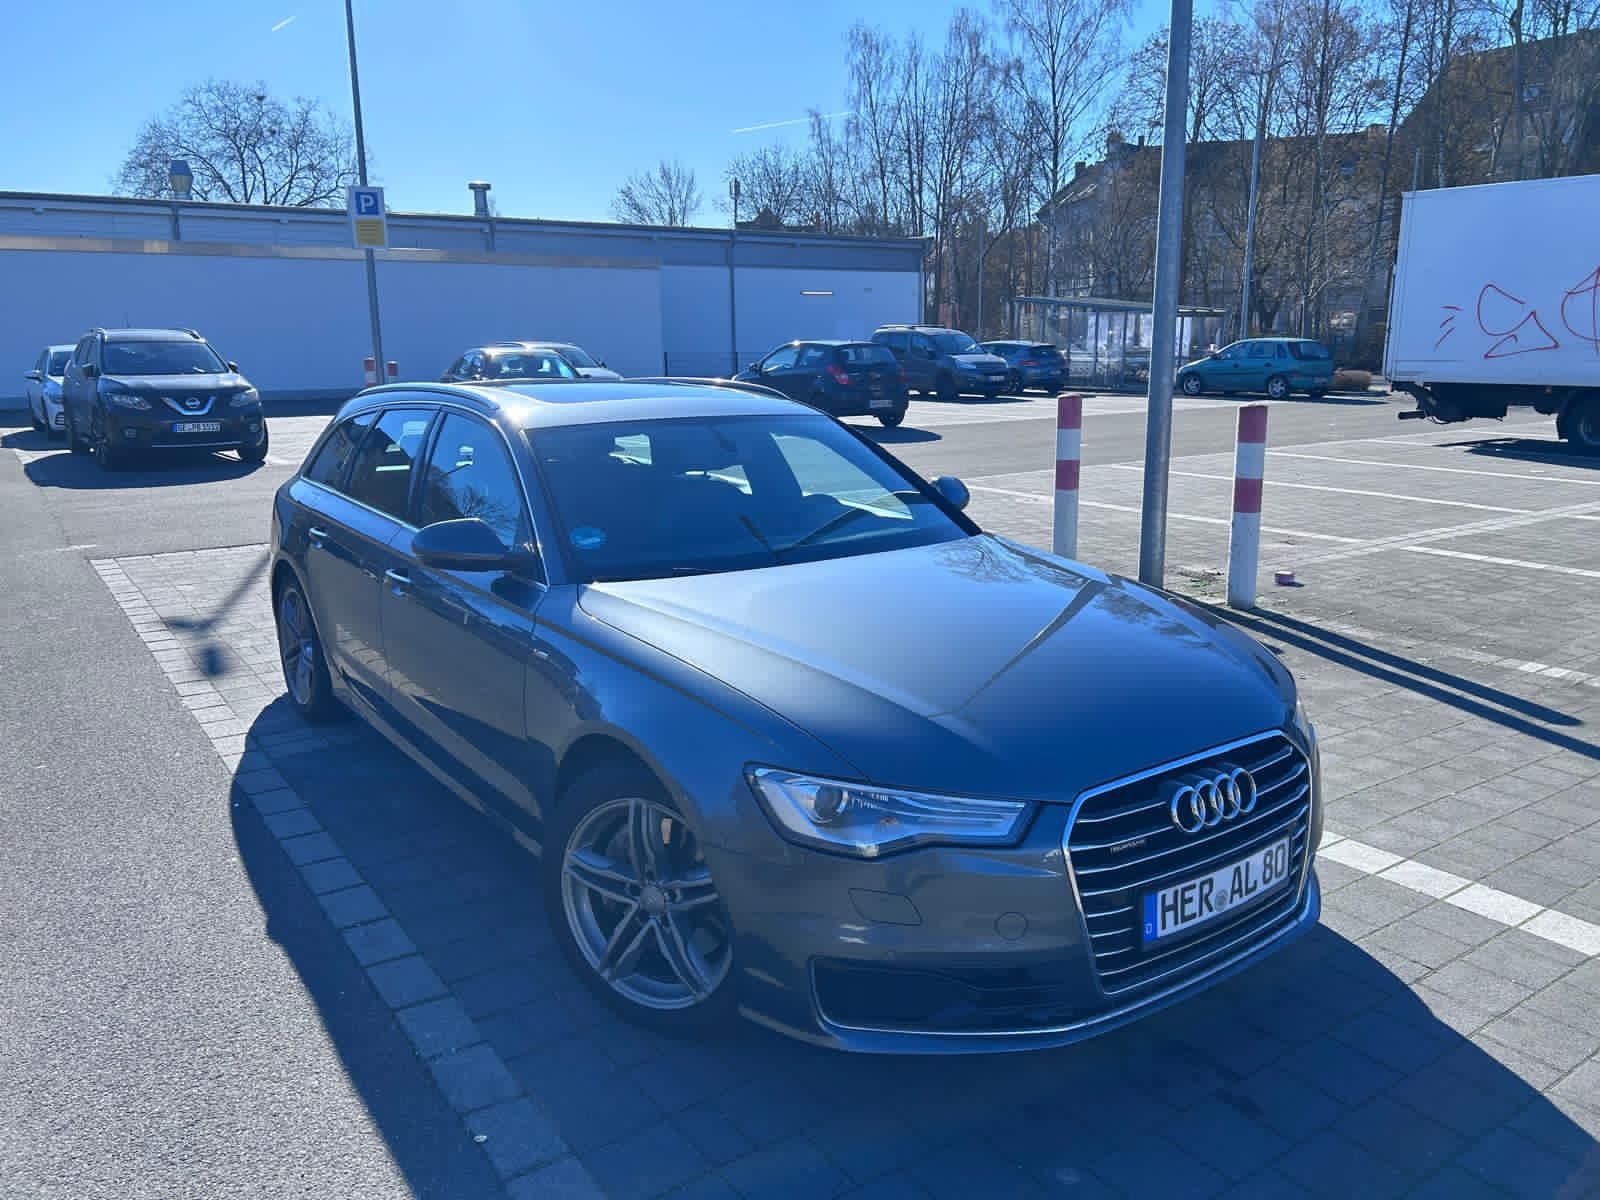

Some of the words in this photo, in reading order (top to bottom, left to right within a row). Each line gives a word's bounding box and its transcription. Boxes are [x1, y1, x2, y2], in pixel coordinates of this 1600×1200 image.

[360, 194, 375, 213] P
[1161, 877, 1215, 930] HER
[1230, 861, 1257, 904] AL
[1262, 843, 1286, 884] 80
